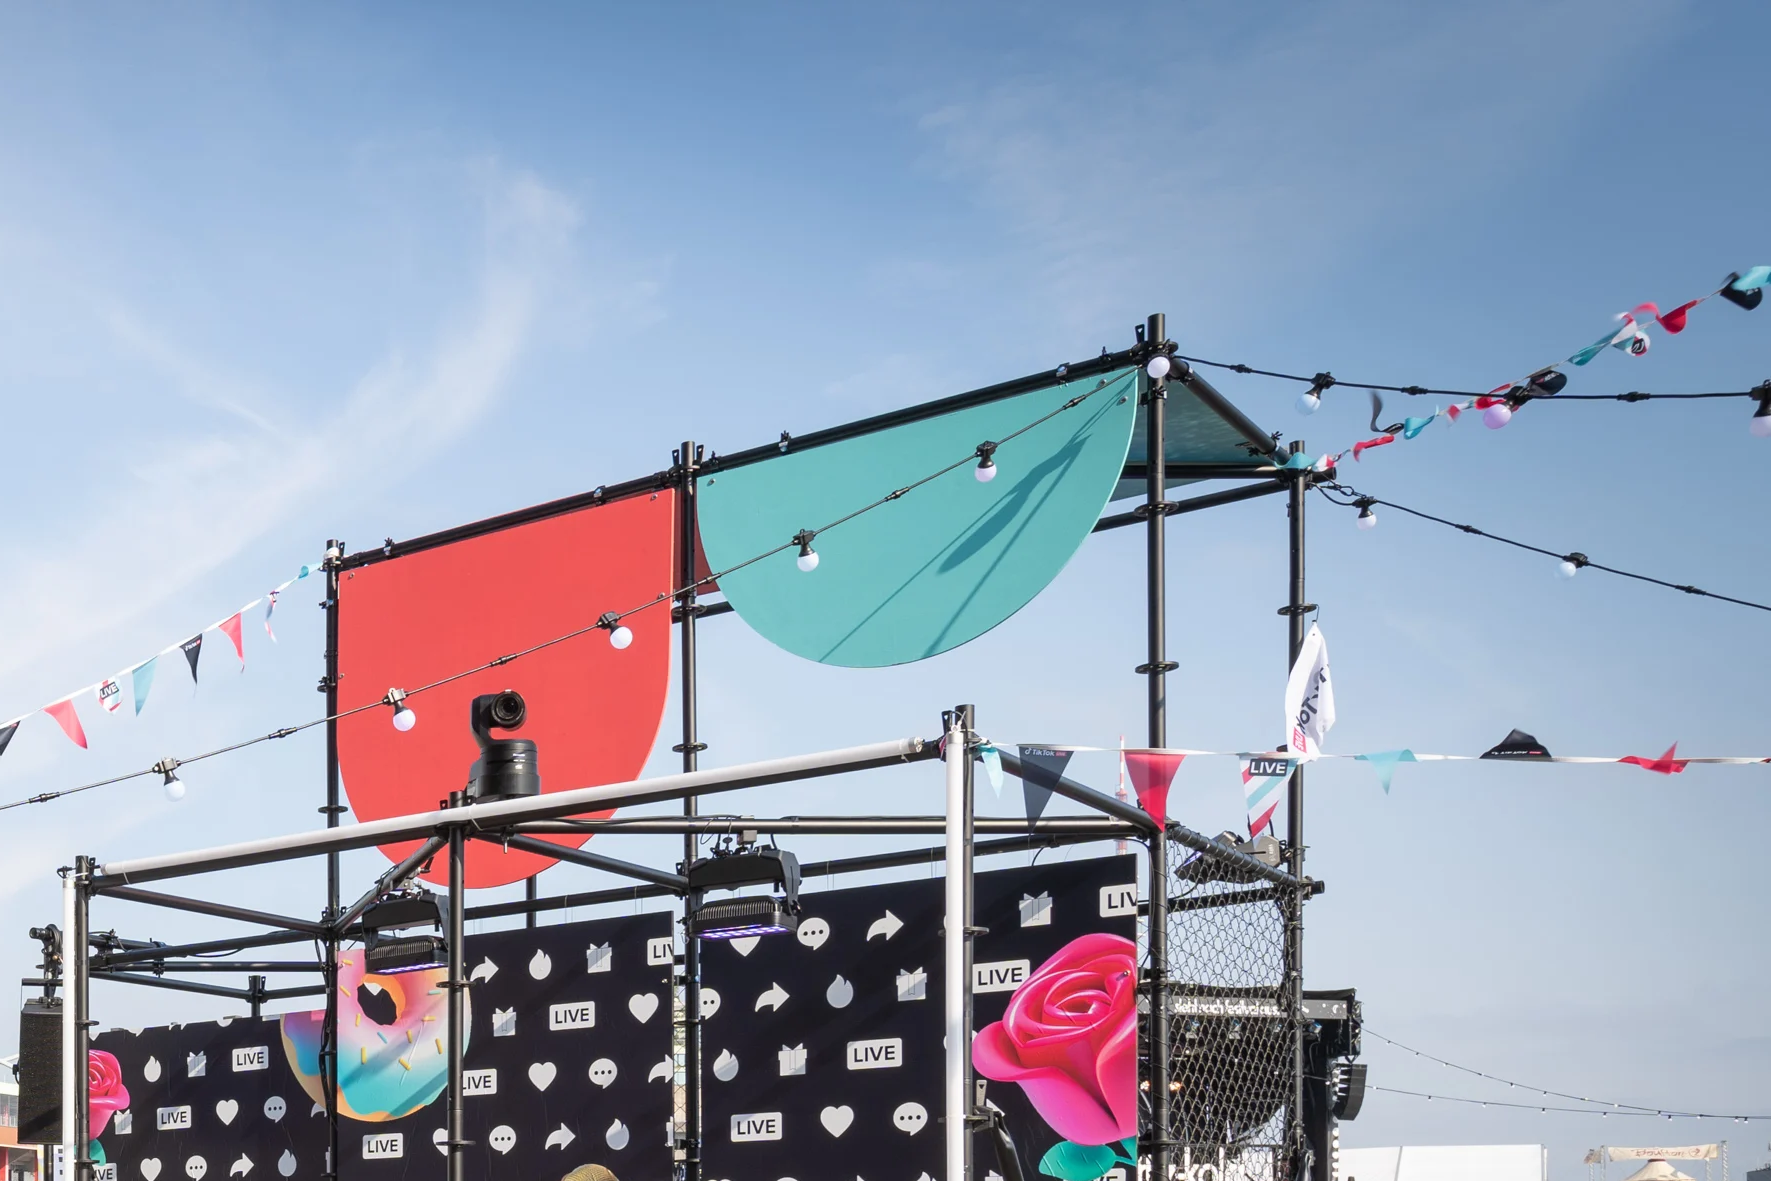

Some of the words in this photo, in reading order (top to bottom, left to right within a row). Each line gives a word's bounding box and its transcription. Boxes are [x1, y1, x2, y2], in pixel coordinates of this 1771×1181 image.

[100, 682, 118, 698] LIVE
[1032, 748, 1055, 756] TikTok
[1250, 761, 1286, 774] LIVE
[1108, 891, 1137, 909] LIV
[653, 944, 673, 959] LIV
[977, 967, 1023, 985] LIVE
[554, 1007, 590, 1024] LIVE
[236, 1051, 265, 1066] LIVE
[853, 1045, 895, 1063] LIVE
[161, 1110, 188, 1125] LIVE
[737, 1119, 776, 1135] LIVE
[367, 1140, 399, 1154] LIVE
